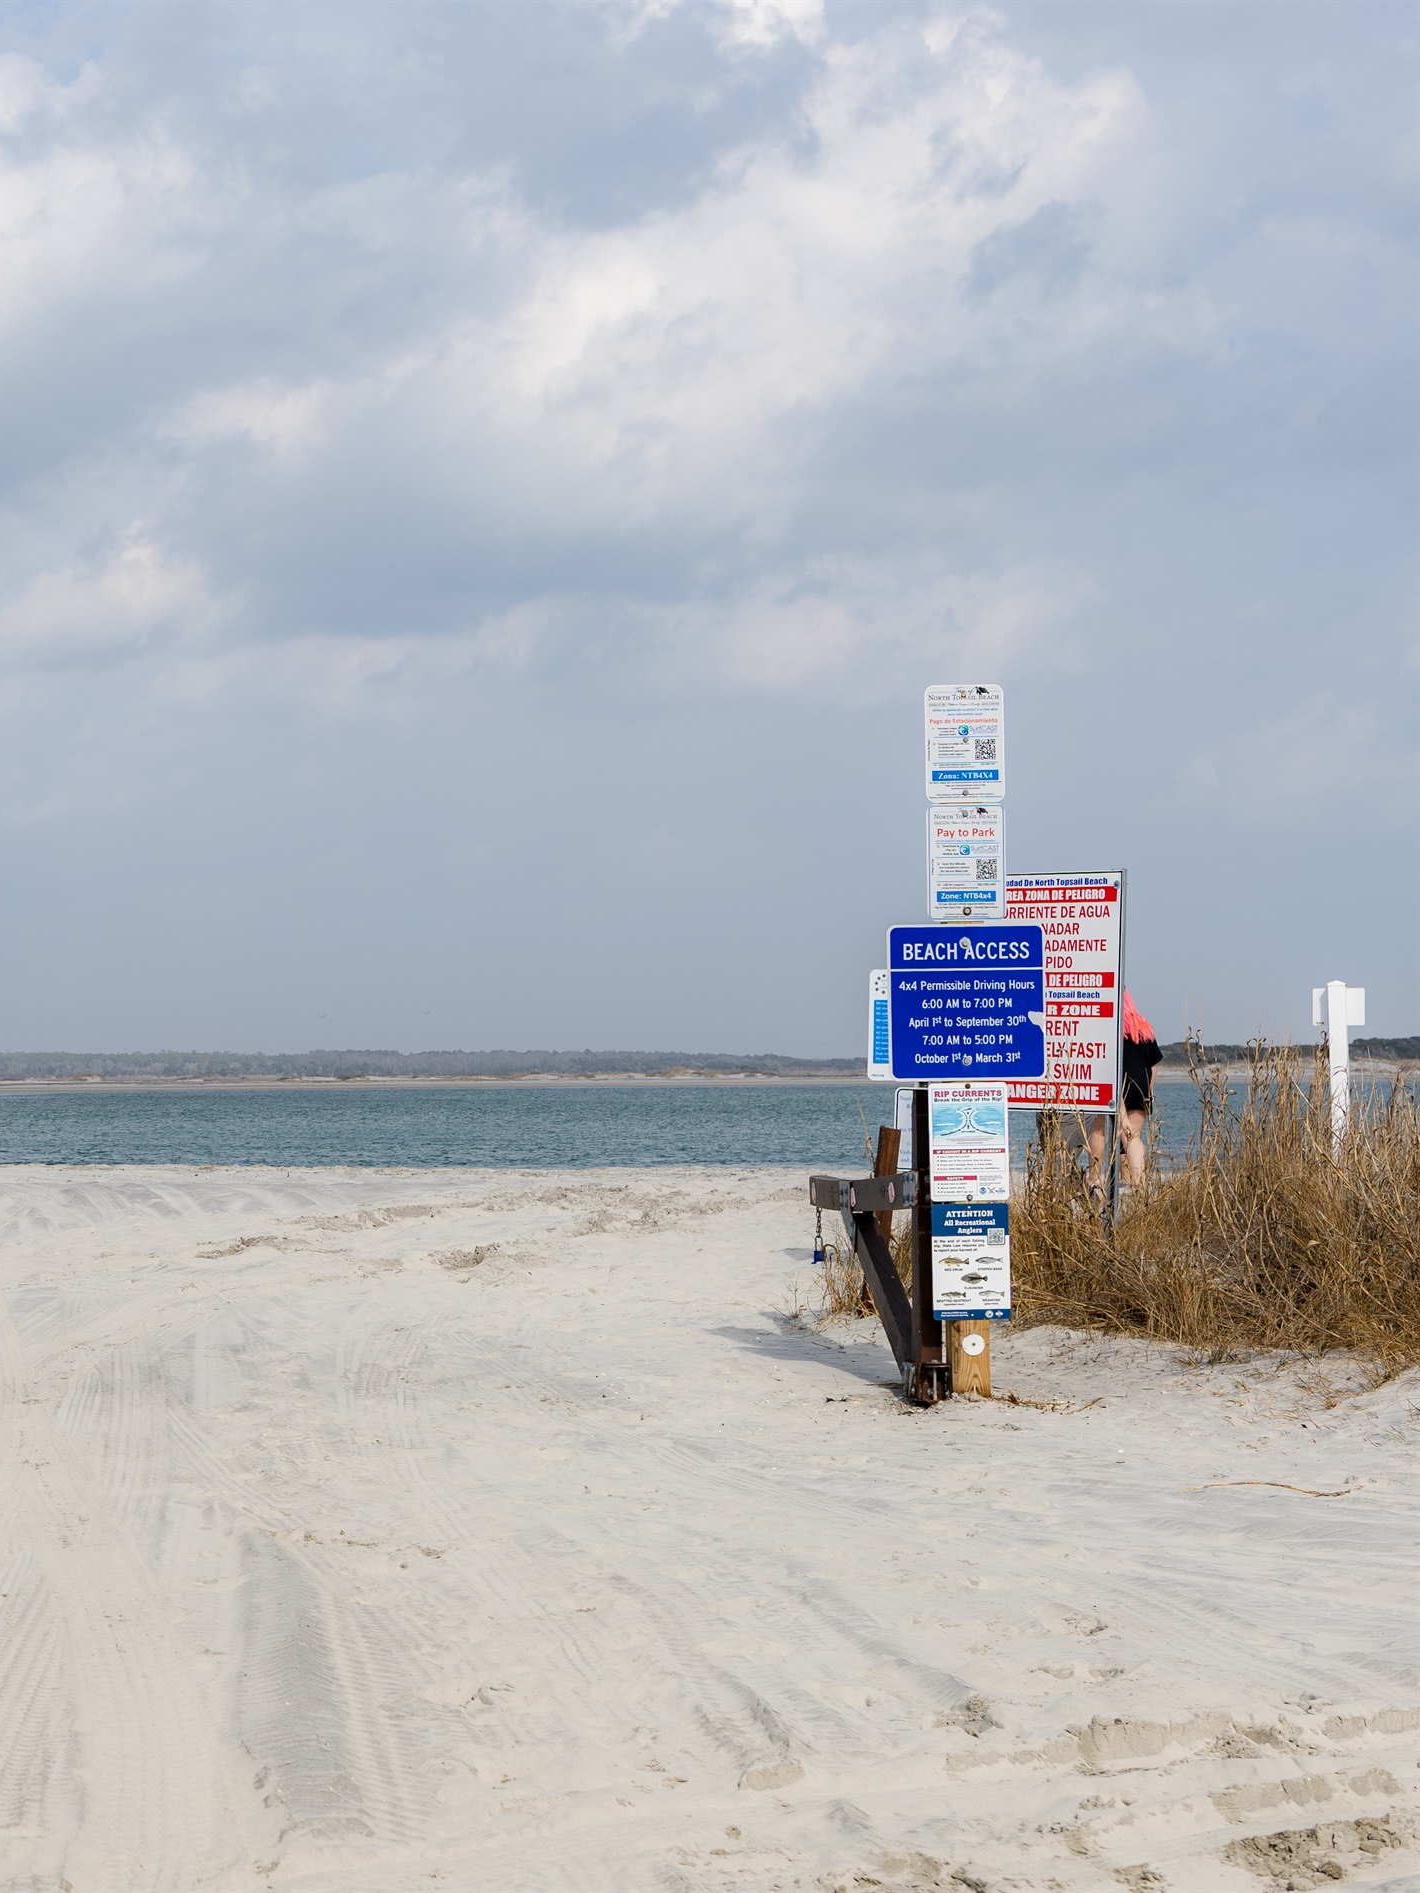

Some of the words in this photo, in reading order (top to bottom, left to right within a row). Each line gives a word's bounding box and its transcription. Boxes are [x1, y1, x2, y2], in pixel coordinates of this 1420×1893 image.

[970, 724, 998, 732] SurfCAST
[938, 772, 959, 780] Zona:
[937, 828, 955, 839] Pay
[972, 828, 995, 836] Park
[1035, 878, 1054, 886] North
[1056, 878, 1083, 886] Topsail
[1007, 890, 1023, 901] REA
[1025, 890, 1050, 901] ZONA
[1052, 890, 1064, 900] DE
[1066, 888, 1106, 900] PELIGRO
[1061, 906, 1075, 918] DE
[1079, 905, 1110, 918] AGUA
[1042, 923, 1080, 935] NADAR
[903, 943, 958, 960] BEACH
[964, 942, 1029, 960] ACCESS
[1045, 939, 1107, 952] ADAMENTE
[1046, 956, 1072, 968] PIDO
[899, 981, 917, 990] 4x4
[920, 980, 971, 990] Permissible
[974, 980, 1006, 992] Driving
[1009, 980, 1035, 989] Hours
[1049, 974, 1061, 986] DE
[1063, 974, 1103, 987] PELIGRO
[1049, 991, 1075, 999] Topsail
[922, 999, 942, 1009] 6:00
[946, 999, 959, 1008] AM
[962, 999, 971, 1008] to
[974, 998, 994, 1008] 7:00
[998, 998, 1012, 1008] PM
[1061, 1005, 1100, 1016] ZONE
[909, 1018, 929, 1029] April
[932, 1016, 942, 1027] 1st
[944, 1018, 953, 1027] to
[956, 1017, 1004, 1028] September
[1007, 1015, 1026, 1026] 30th
[1046, 1021, 1079, 1036] RENT
[923, 1036, 943, 1045] 7:00
[947, 1036, 960, 1045] AM
[962, 1036, 972, 1044] to
[975, 1035, 995, 1044] 5:00
[999, 1035, 1013, 1044] PM
[1070, 1042, 1106, 1059] FAST!
[915, 1053, 948, 1064] October
[952, 1052, 961, 1063] 1st
[976, 1053, 1002, 1063] March
[1006, 1051, 1021, 1062] 31st
[1054, 1064, 1091, 1080] SWIM
[1007, 1084, 1057, 1099] ANGER
[1060, 1086, 1099, 1101] ZONE
